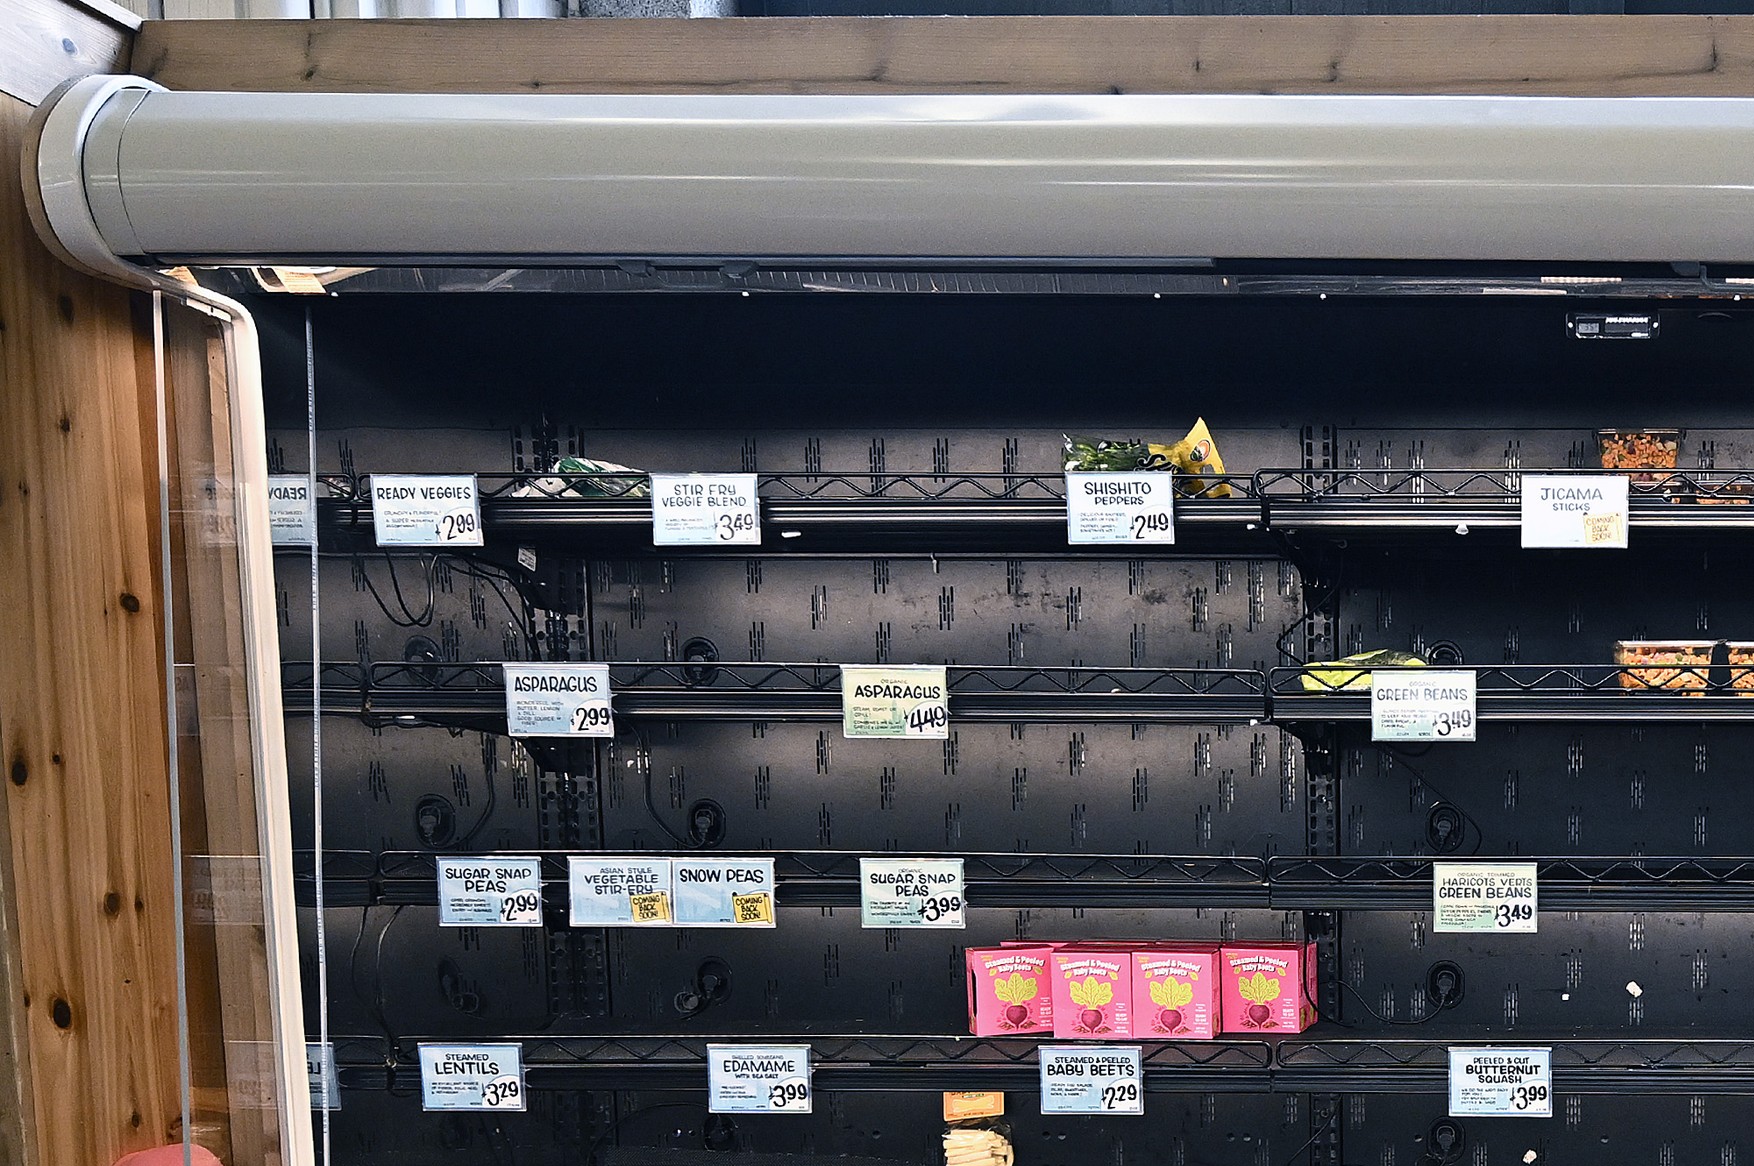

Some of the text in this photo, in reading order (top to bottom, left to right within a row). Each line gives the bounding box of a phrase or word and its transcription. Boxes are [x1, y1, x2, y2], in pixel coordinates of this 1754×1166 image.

[377, 487, 471, 500] READY VEGGIES
[674, 484, 736, 495] STIR FRY
[1084, 482, 1152, 495] SHISHITO
[1541, 488, 1602, 500] JICAMA
[662, 497, 746, 507] VEGGIE BLEND
[1095, 496, 1144, 505] PEPPERS
[1553, 503, 1590, 512] STICKS
[515, 676, 597, 692] ASPARAGUS
[855, 686, 940, 699] ASPARAGUS
[1377, 688, 1468, 701] GREEN BEANS
[445, 868, 531, 879] SUGAR SNAP
[585, 874, 658, 884] VEGETABLE
[680, 869, 764, 883] SNOW PEAS
[870, 874, 956, 885] SUGAR SNAP
[1443, 878, 1532, 887] HARICOTS VERTS
[465, 881, 506, 893] PEAS
[595, 885, 653, 894] STIR-FRY
[896, 885, 929, 897] PEAS
[1439, 887, 1532, 898] GREEN BEANS
[633, 895, 660, 905] COMING
[735, 897, 763, 906] COMING
[639, 904, 653, 913] BACK
[741, 912, 760, 920] SOON!
[723, 1060, 795, 1072] EDAMAME
[1516, 1057, 1529, 1065] CUT
[435, 1062, 499, 1075] LENTILS
[1047, 1065, 1134, 1076] BABY BEETS
[1466, 1065, 1541, 1075] BUTTERNUT
[1478, 1075, 1522, 1084] SQUASH
